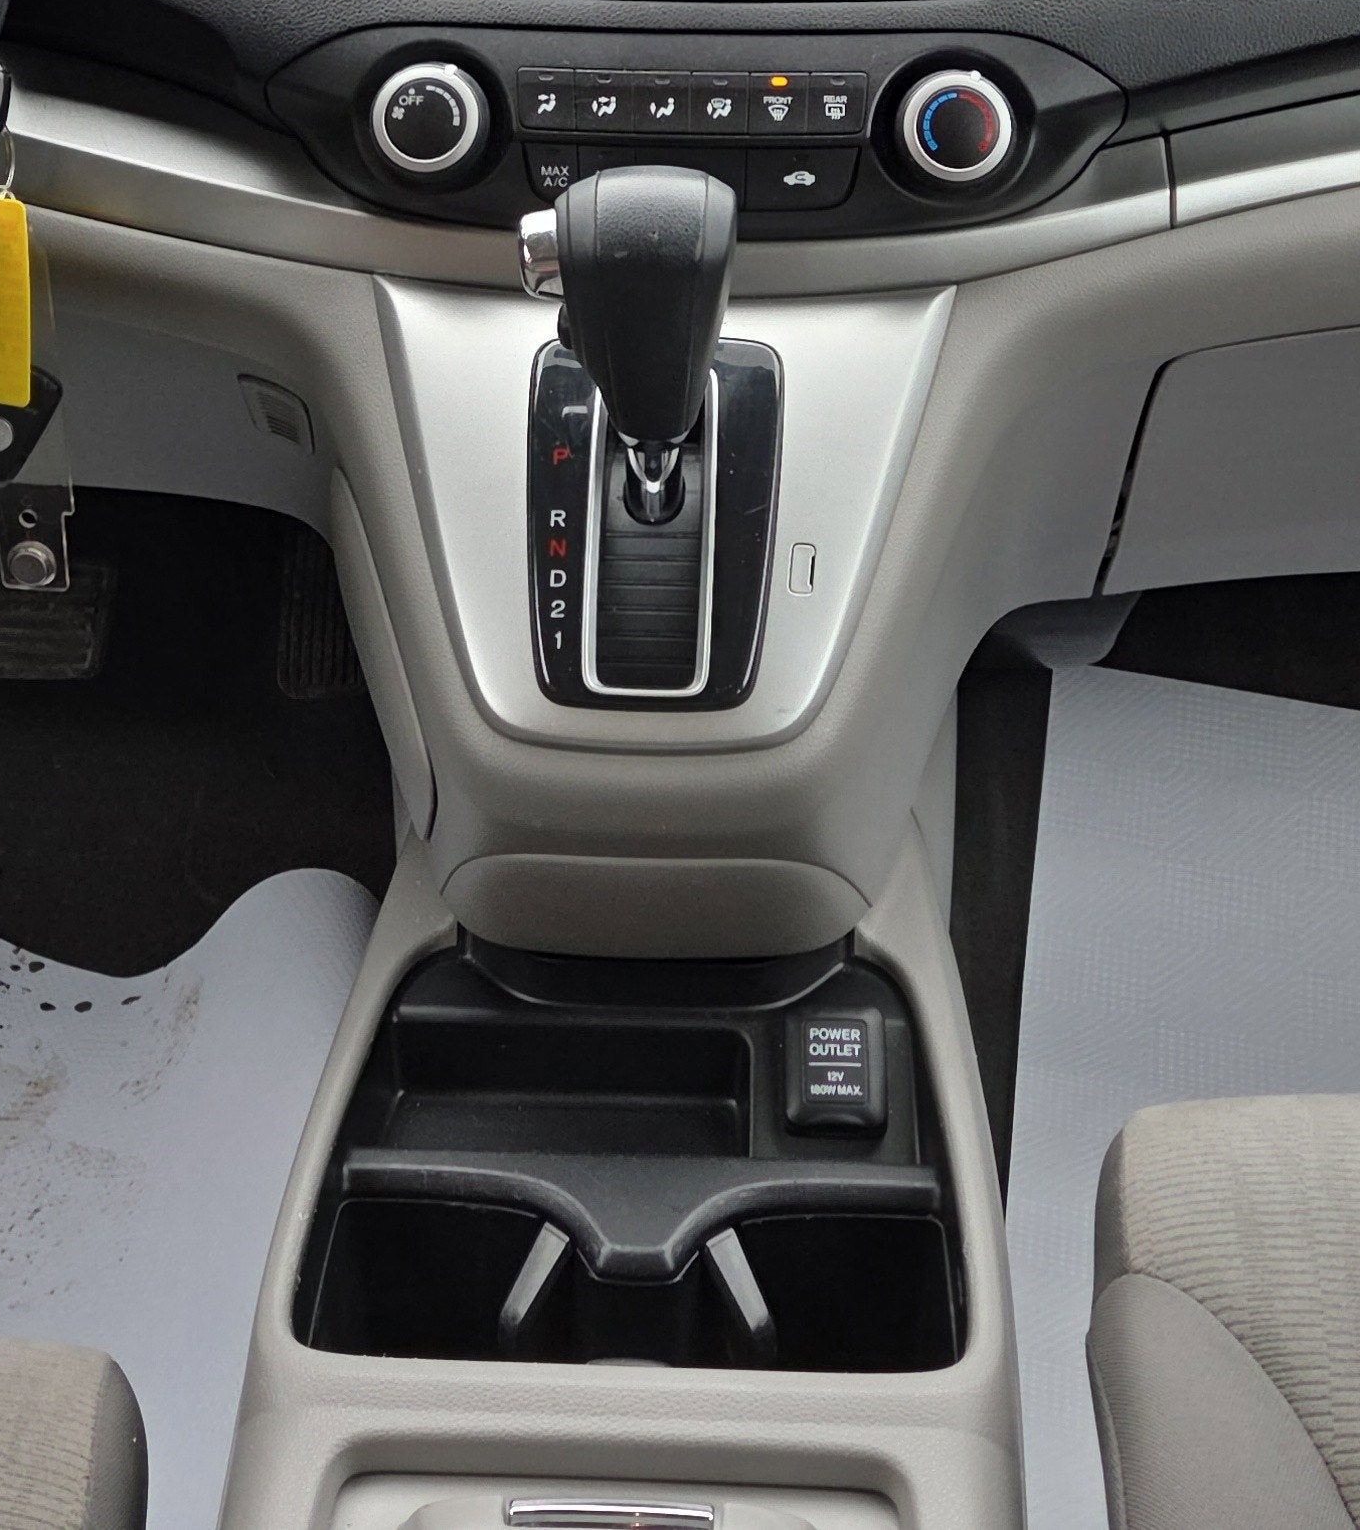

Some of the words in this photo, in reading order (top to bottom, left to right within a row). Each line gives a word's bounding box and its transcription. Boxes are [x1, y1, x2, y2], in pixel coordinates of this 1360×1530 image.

[398, 95, 425, 106] OFF
[763, 96, 793, 105] FRONT
[823, 95, 848, 103] REAR
[541, 166, 570, 176] MAX
[543, 176, 569, 188] A/C
[552, 447, 570, 465] P
[549, 510, 567, 528] R
[549, 539, 567, 557] N
[549, 569, 567, 588] D
[550, 600, 567, 619] 2
[554, 631, 563, 649] 1
[809, 1027, 861, 1042] POWER
[809, 1043, 862, 1057] OUTLET
[827, 1071, 844, 1082] 12V
